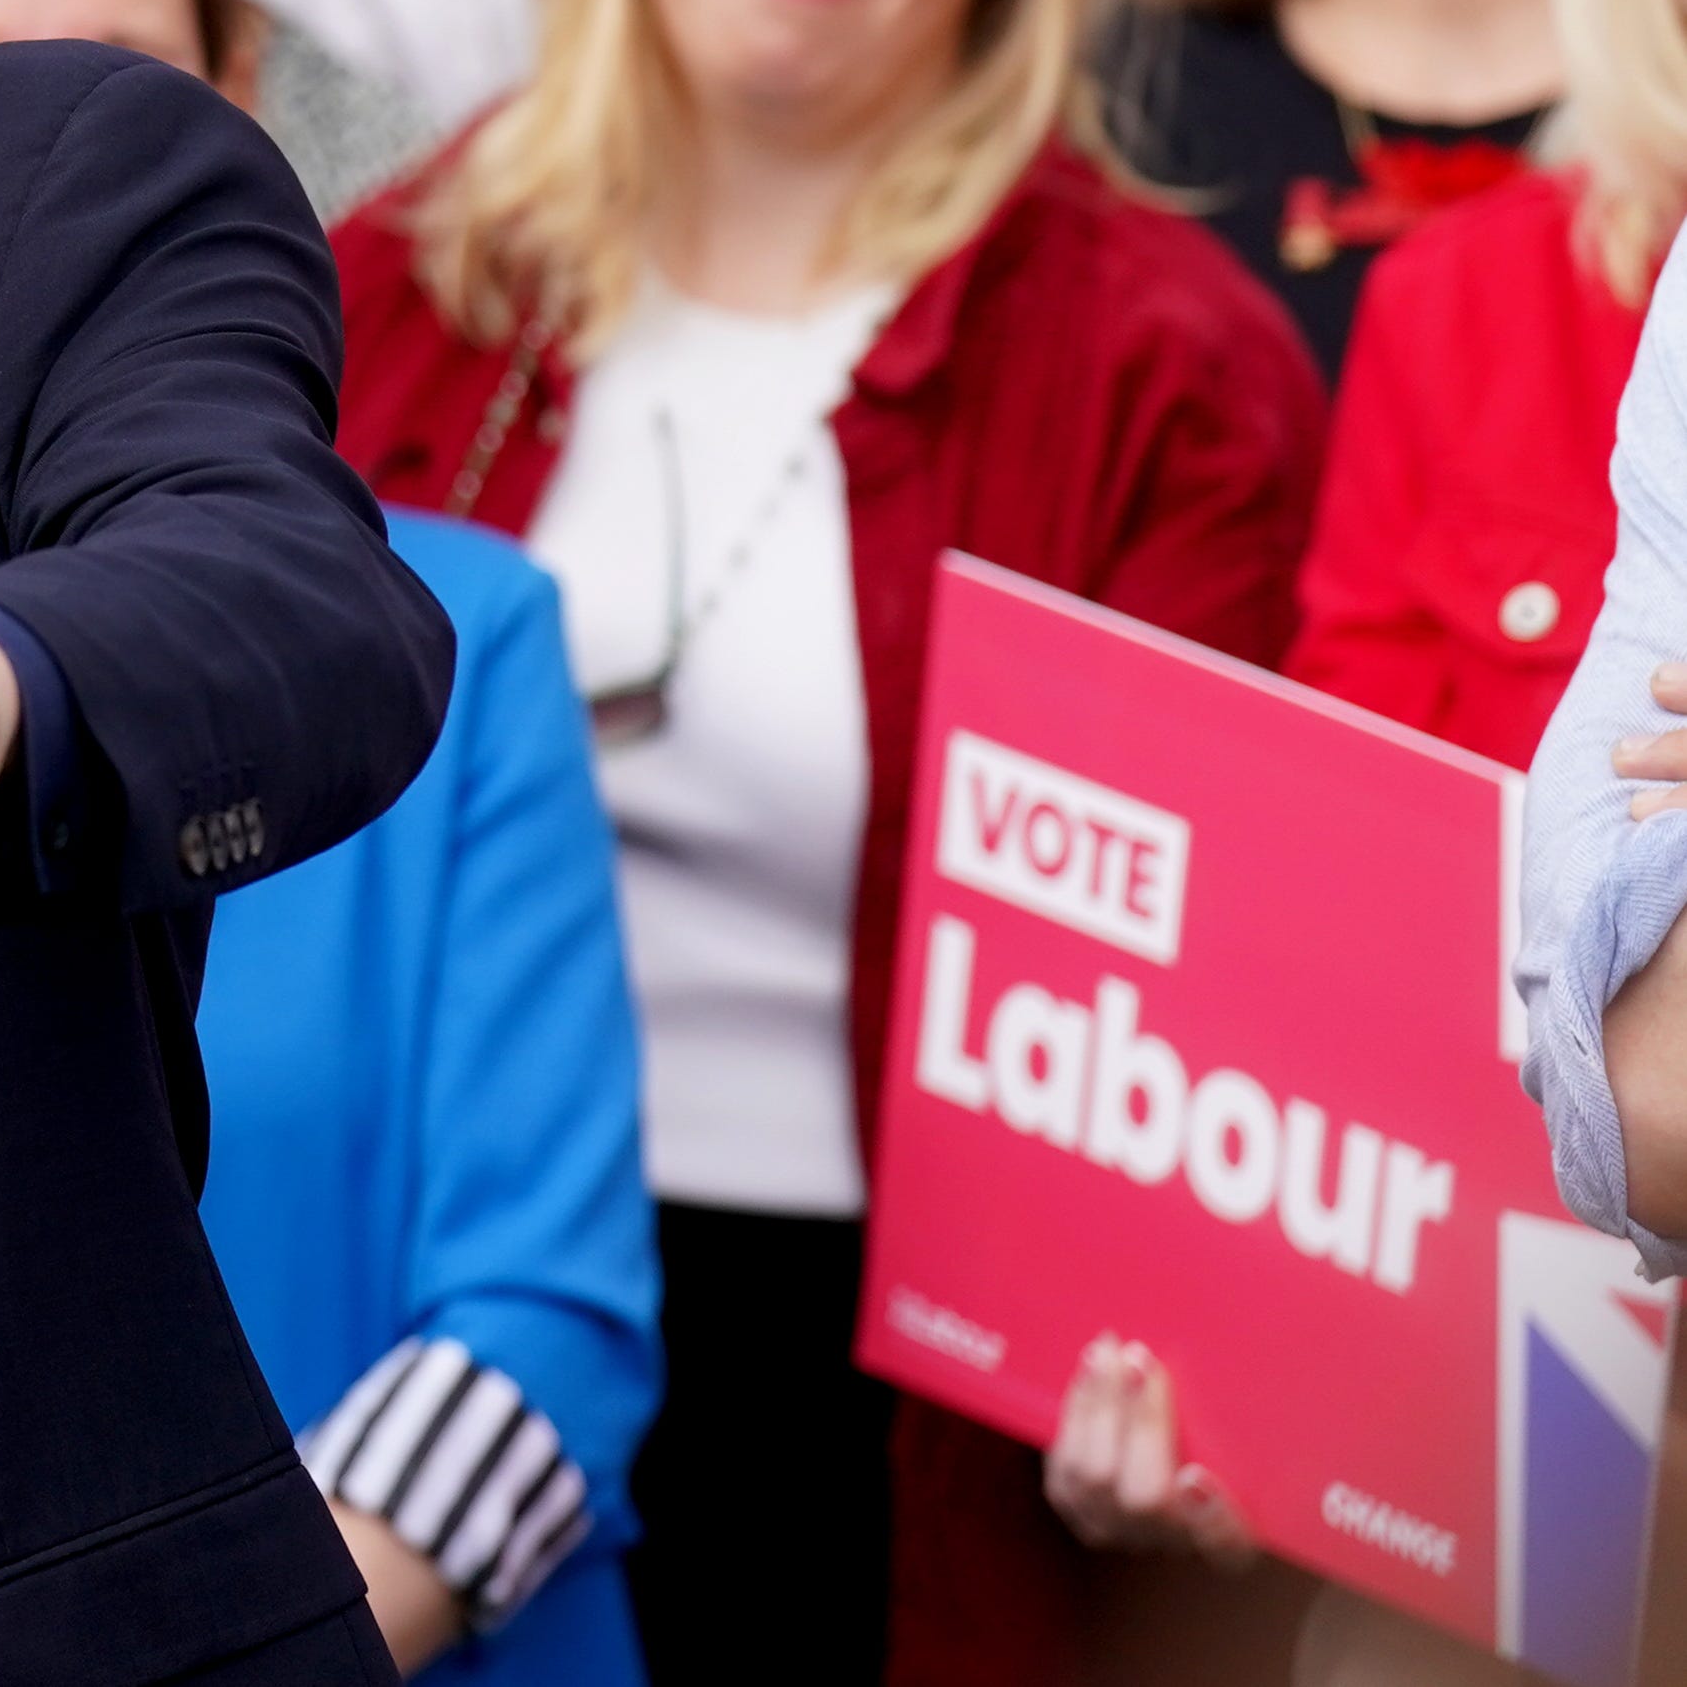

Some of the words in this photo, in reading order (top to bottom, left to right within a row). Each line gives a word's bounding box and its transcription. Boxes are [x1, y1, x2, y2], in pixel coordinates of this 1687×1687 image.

[972, 766, 1161, 920] VOTE
[916, 915, 1455, 1295] Labour
[1321, 1482, 1457, 1576] CHANGE
